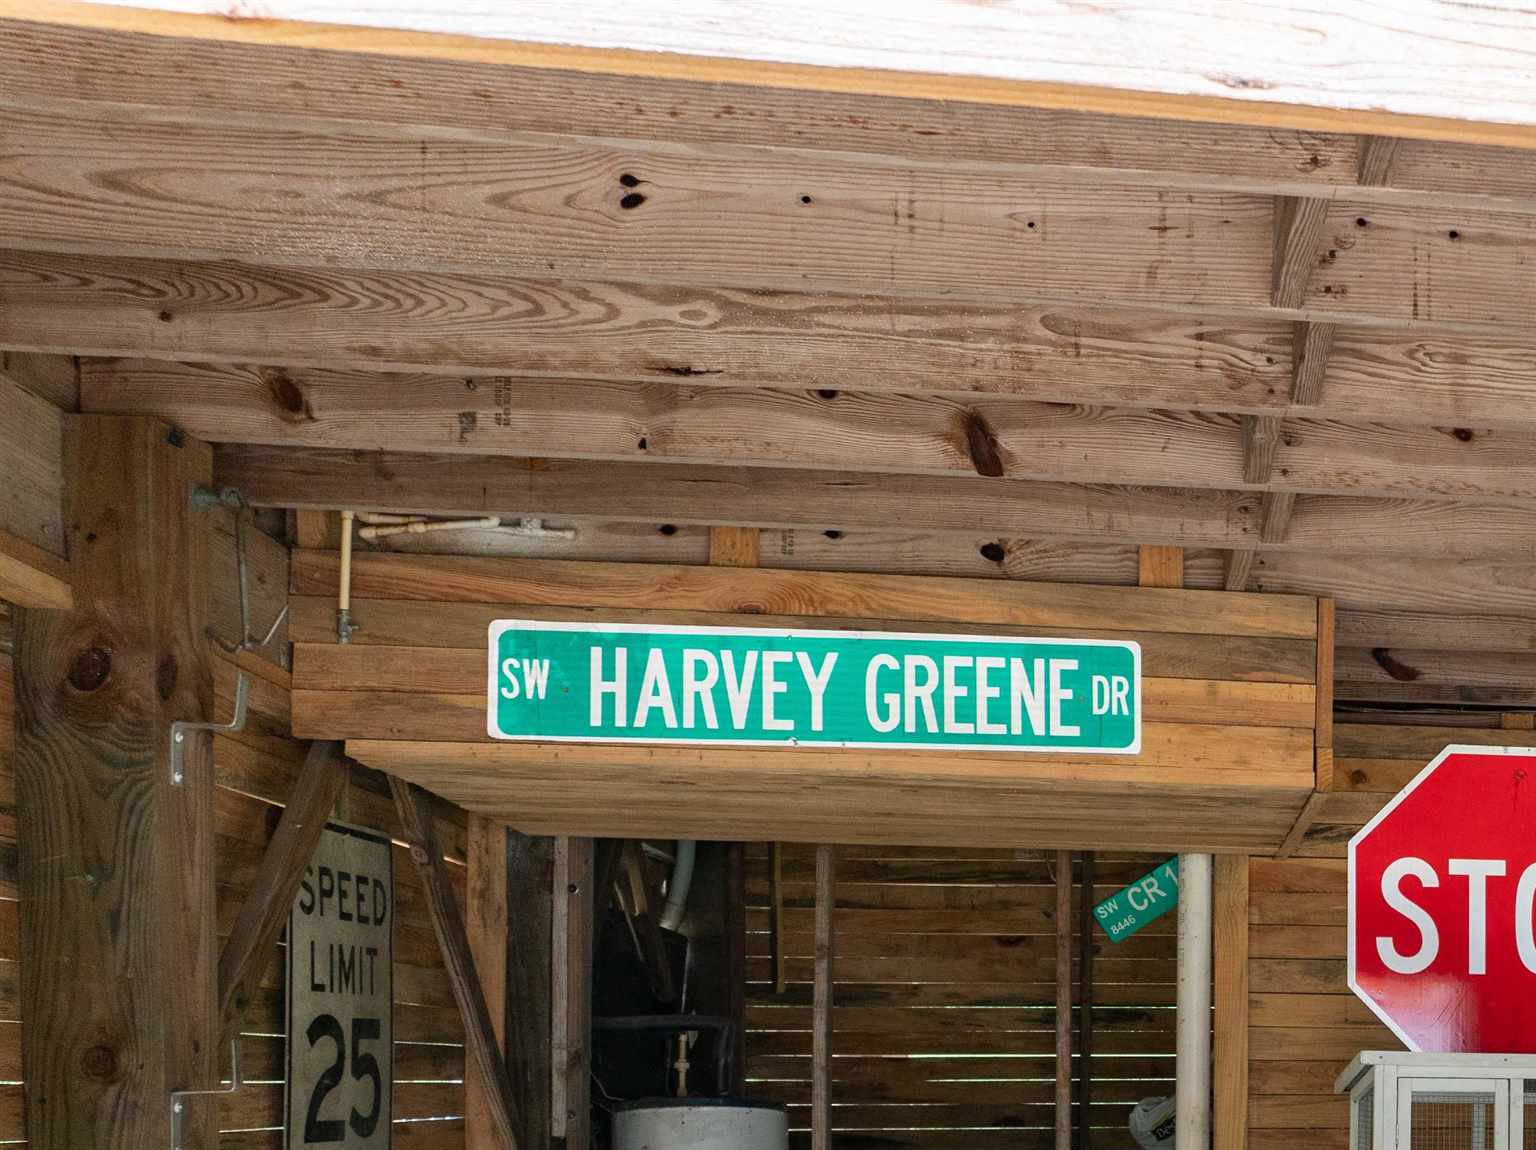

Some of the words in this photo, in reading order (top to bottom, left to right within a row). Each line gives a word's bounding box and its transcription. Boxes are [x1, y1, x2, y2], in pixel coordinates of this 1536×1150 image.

[500, 658, 549, 700] SW
[589, 646, 839, 731] HARVEY
[865, 653, 1080, 737] GREENE
[1091, 675, 1130, 716] DR
[299, 865, 388, 927] SPEED
[1097, 899, 1119, 919] SW
[1127, 876, 1168, 911] CR
[310, 940, 378, 996] LIMIT
[303, 1013, 381, 1144] 25
